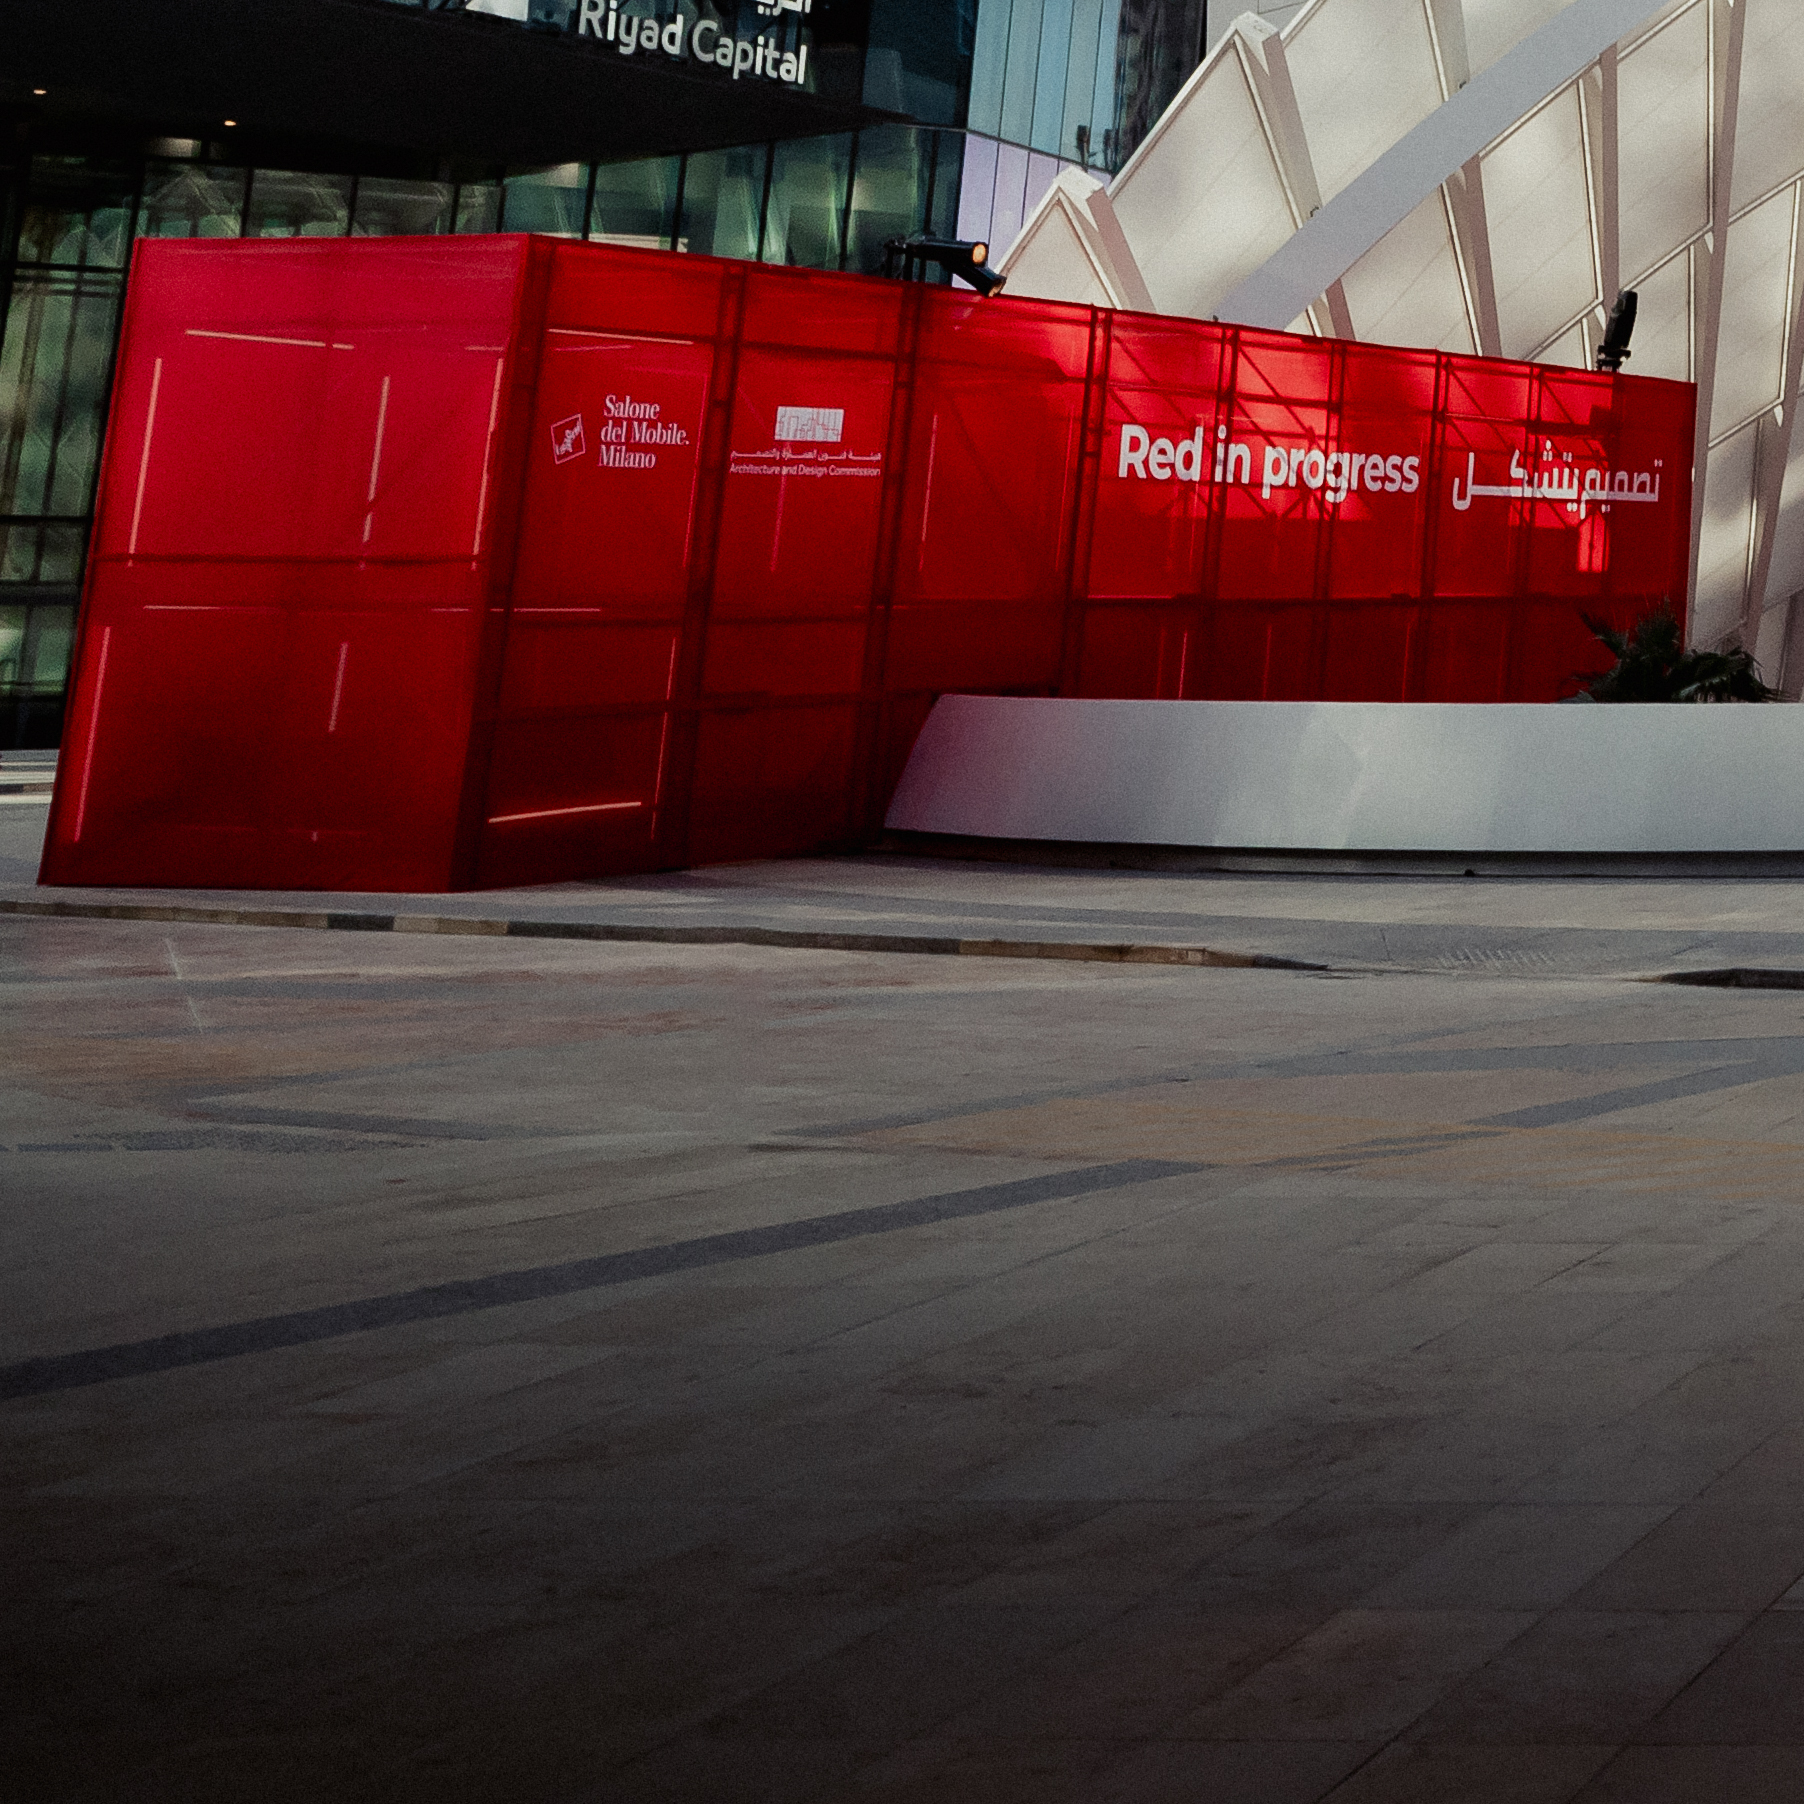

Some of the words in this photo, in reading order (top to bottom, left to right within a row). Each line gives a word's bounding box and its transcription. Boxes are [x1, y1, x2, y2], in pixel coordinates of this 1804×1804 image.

[692, 19, 807, 85] Capital
[603, 394, 660, 420] Salone
[600, 419, 627, 443] del
[630, 420, 690, 445] Mobile.
[597, 444, 656, 469] Milano
[798, 464, 827, 477] Design
[829, 464, 881, 476] Commission
[1118, 423, 1203, 482] Red
[1214, 424, 1251, 484] in
[1261, 444, 1420, 503] progress
[1452, 439, 1579, 511] يتشكل
[1579, 459, 1663, 520] تصميم
